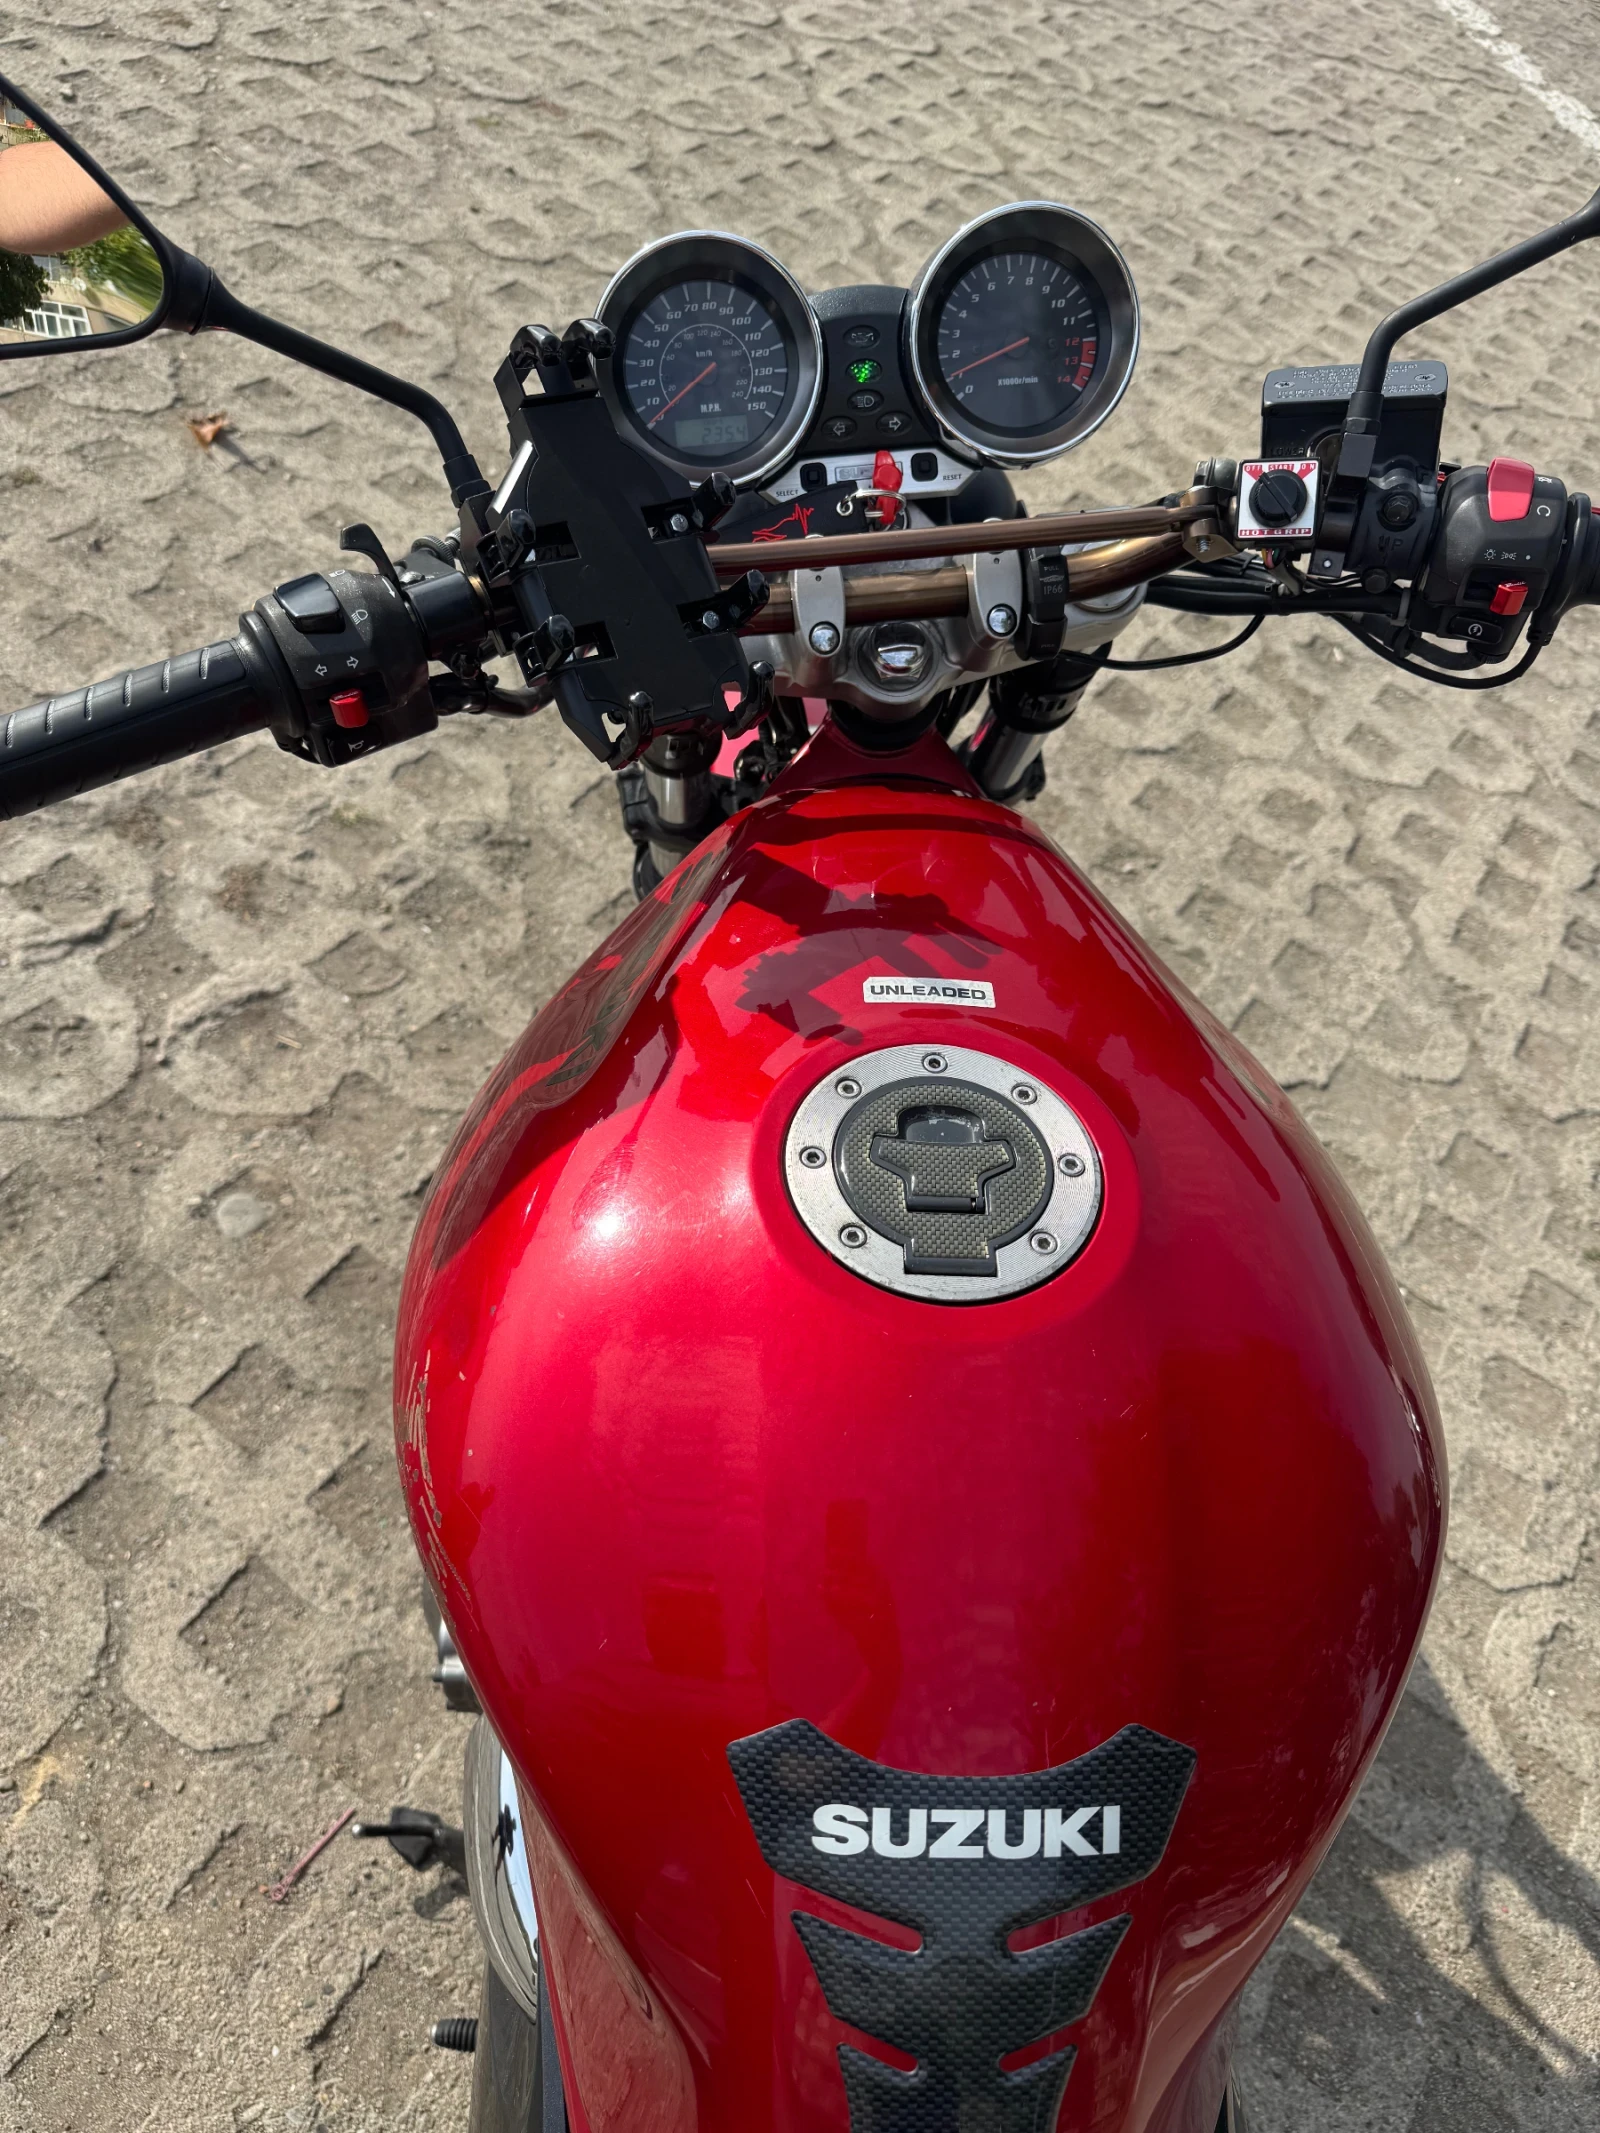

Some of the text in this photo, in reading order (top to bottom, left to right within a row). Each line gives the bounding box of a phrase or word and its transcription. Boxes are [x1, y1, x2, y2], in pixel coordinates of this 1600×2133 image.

[1007, 275, 1015, 285] 7
[1025, 276, 1034, 286] 8
[987, 281, 996, 291] 6
[1042, 285, 1050, 294] 9
[970, 293, 980, 303] 5
[684, 303, 699, 312] 70
[702, 301, 717, 310] 80
[1051, 299, 1066, 309] 10
[666, 311, 682, 320] 60
[719, 306, 734, 316] 90
[958, 309, 968, 319] 4
[731, 316, 752, 326] 100
[1063, 316, 1076, 326] 11
[654, 323, 669, 333] 50
[744, 331, 761, 341] 110
[952, 329, 961, 339] 3
[643, 339, 660, 349] 40
[1065, 336, 1080, 346] 12
[750, 348, 770, 358] 120
[951, 349, 961, 359] 2
[638, 358, 655, 368] 30
[1065, 356, 1079, 366] 13
[754, 366, 773, 377] 130
[640, 378, 656, 387] 20
[1057, 374, 1071, 384] 14
[752, 384, 772, 394] 140
[965, 385, 974, 394] 0
[647, 397, 660, 406] 10
[747, 401, 767, 411] 150
[1245, 464, 1262, 472] OFF
[942, 473, 962, 481] RESET
[775, 489, 799, 498] SELECT
[1043, 584, 1063, 595] IP66
[870, 985, 987, 1001] UNLEADED
[811, 1803, 1121, 1859] SUZUKI
